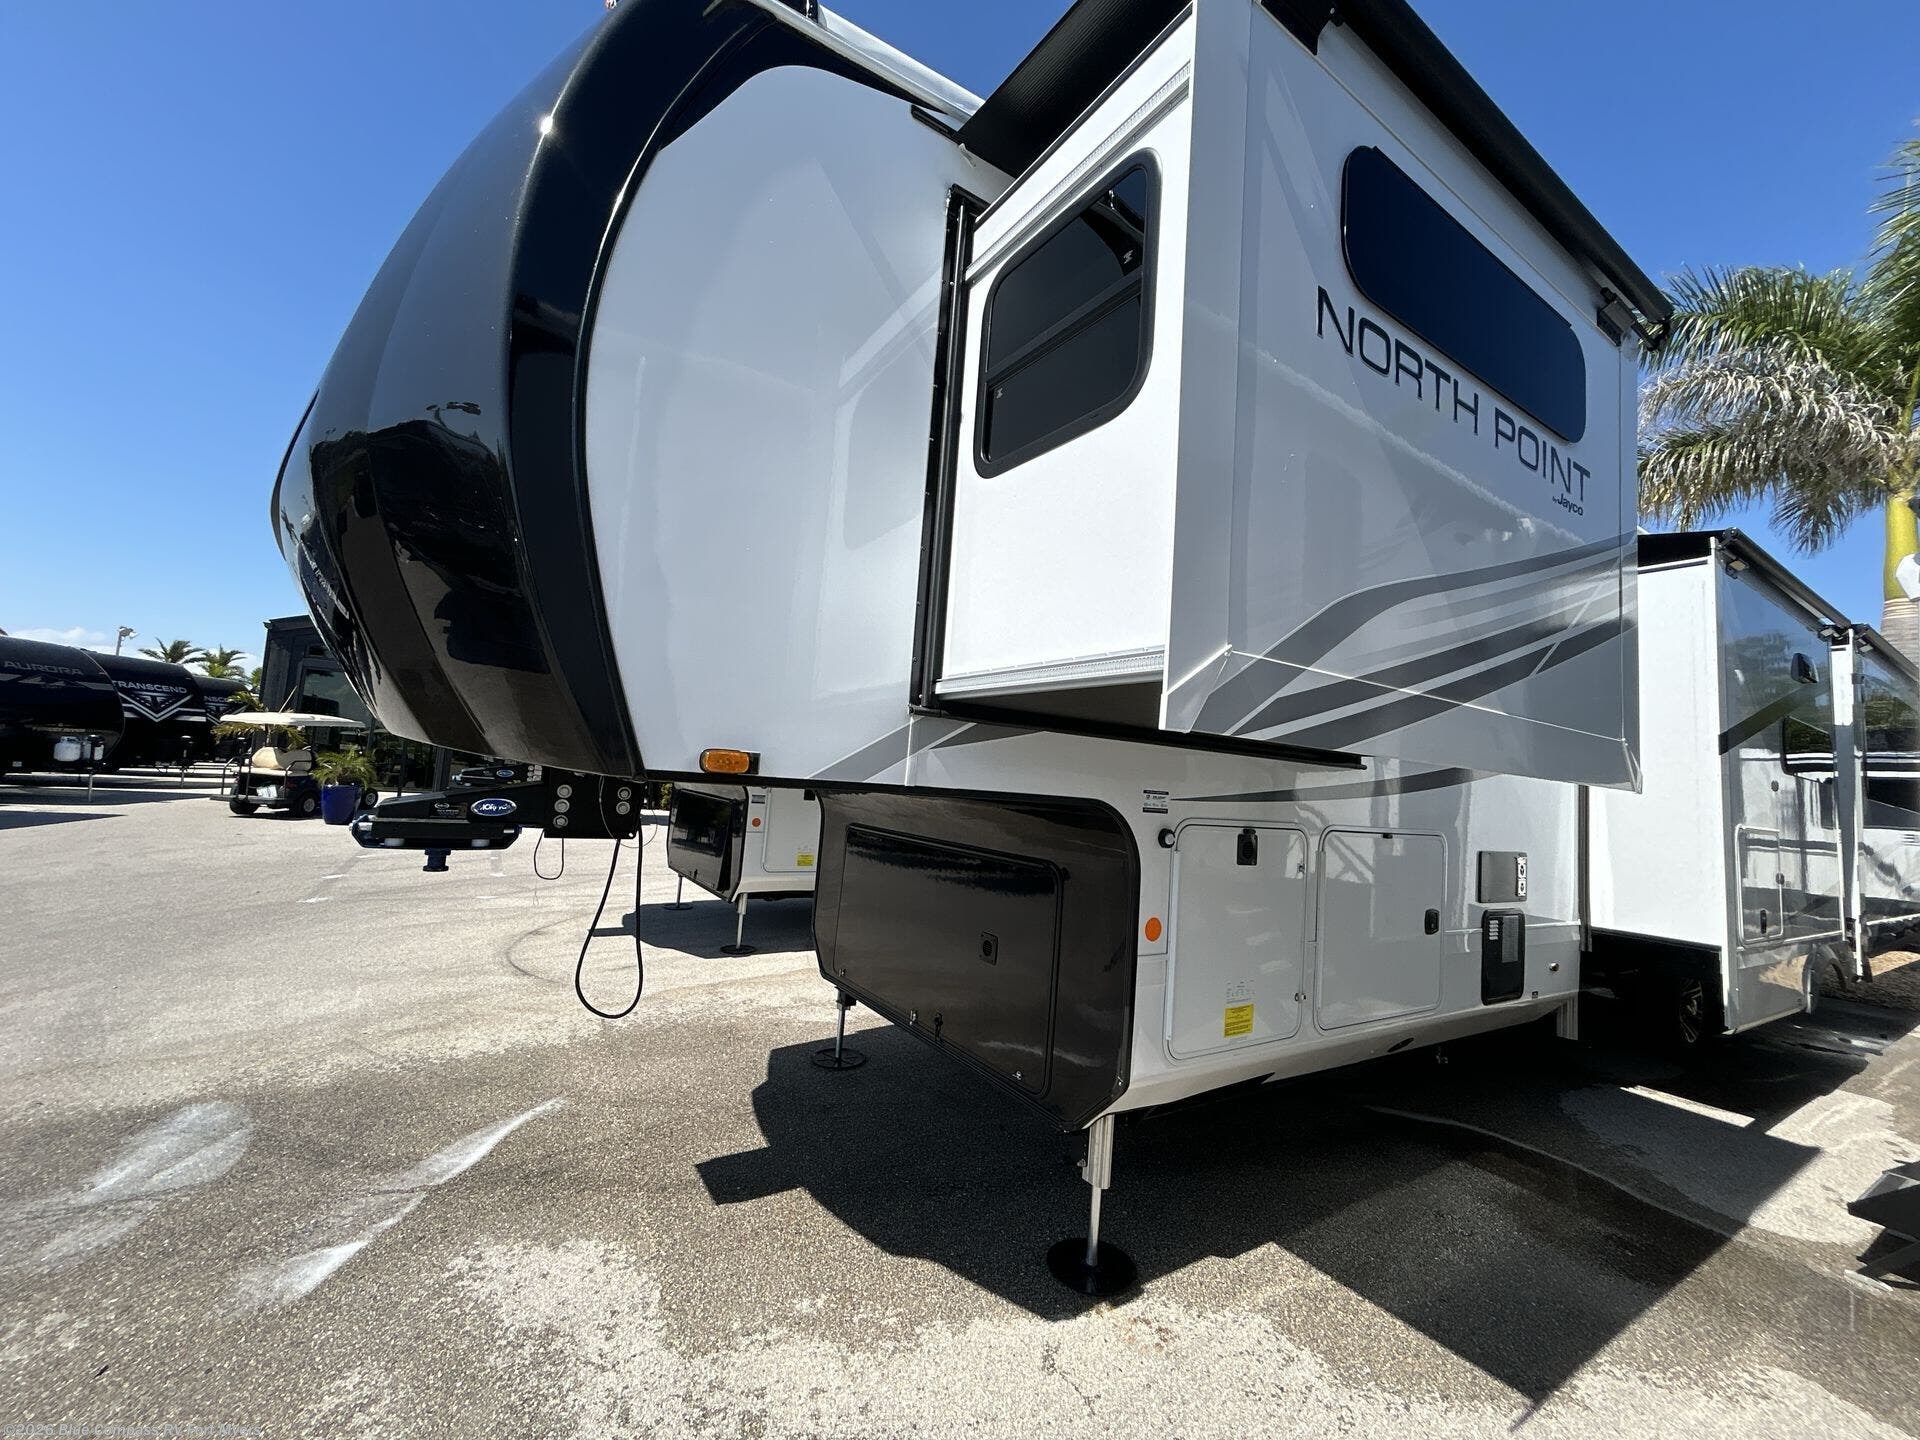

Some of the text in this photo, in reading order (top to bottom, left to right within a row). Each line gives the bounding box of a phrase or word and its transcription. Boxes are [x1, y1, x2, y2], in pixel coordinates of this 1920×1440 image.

[1317, 285, 1590, 501] NORTH POINT
[1558, 493, 1584, 516] Jayco
[4, 661, 84, 676] AURORA
[112, 680, 188, 694] TRANSCEND
